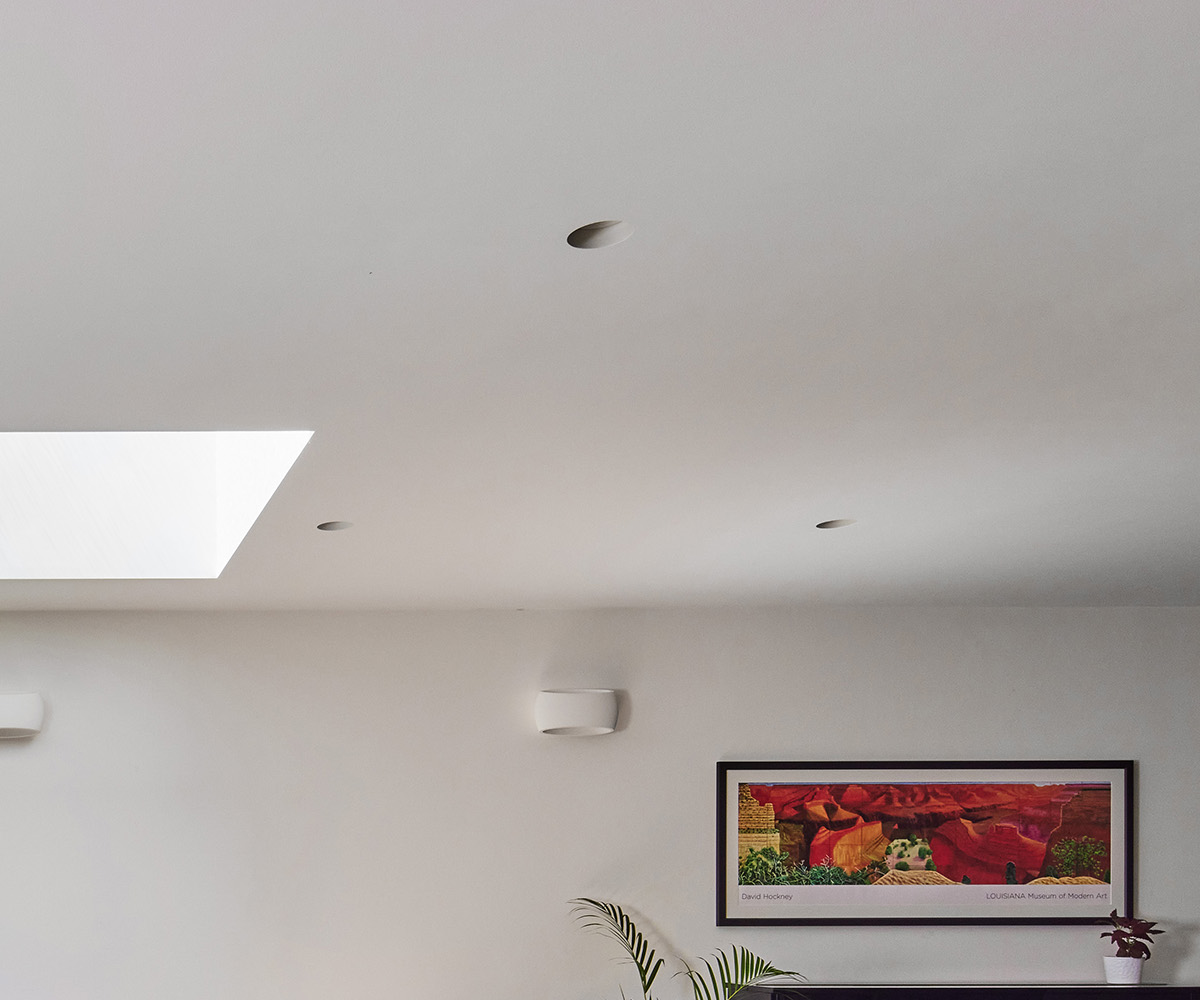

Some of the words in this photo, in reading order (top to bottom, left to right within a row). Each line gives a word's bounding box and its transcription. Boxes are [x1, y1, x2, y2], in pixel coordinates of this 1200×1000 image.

[763, 893, 793, 901] Hockney
[986, 892, 1026, 900] LOUISIANA
[1027, 892, 1057, 900] Museum
[1058, 892, 1066, 900] of
[1067, 892, 1094, 900] Modern
[1095, 892, 1108, 900] Art
